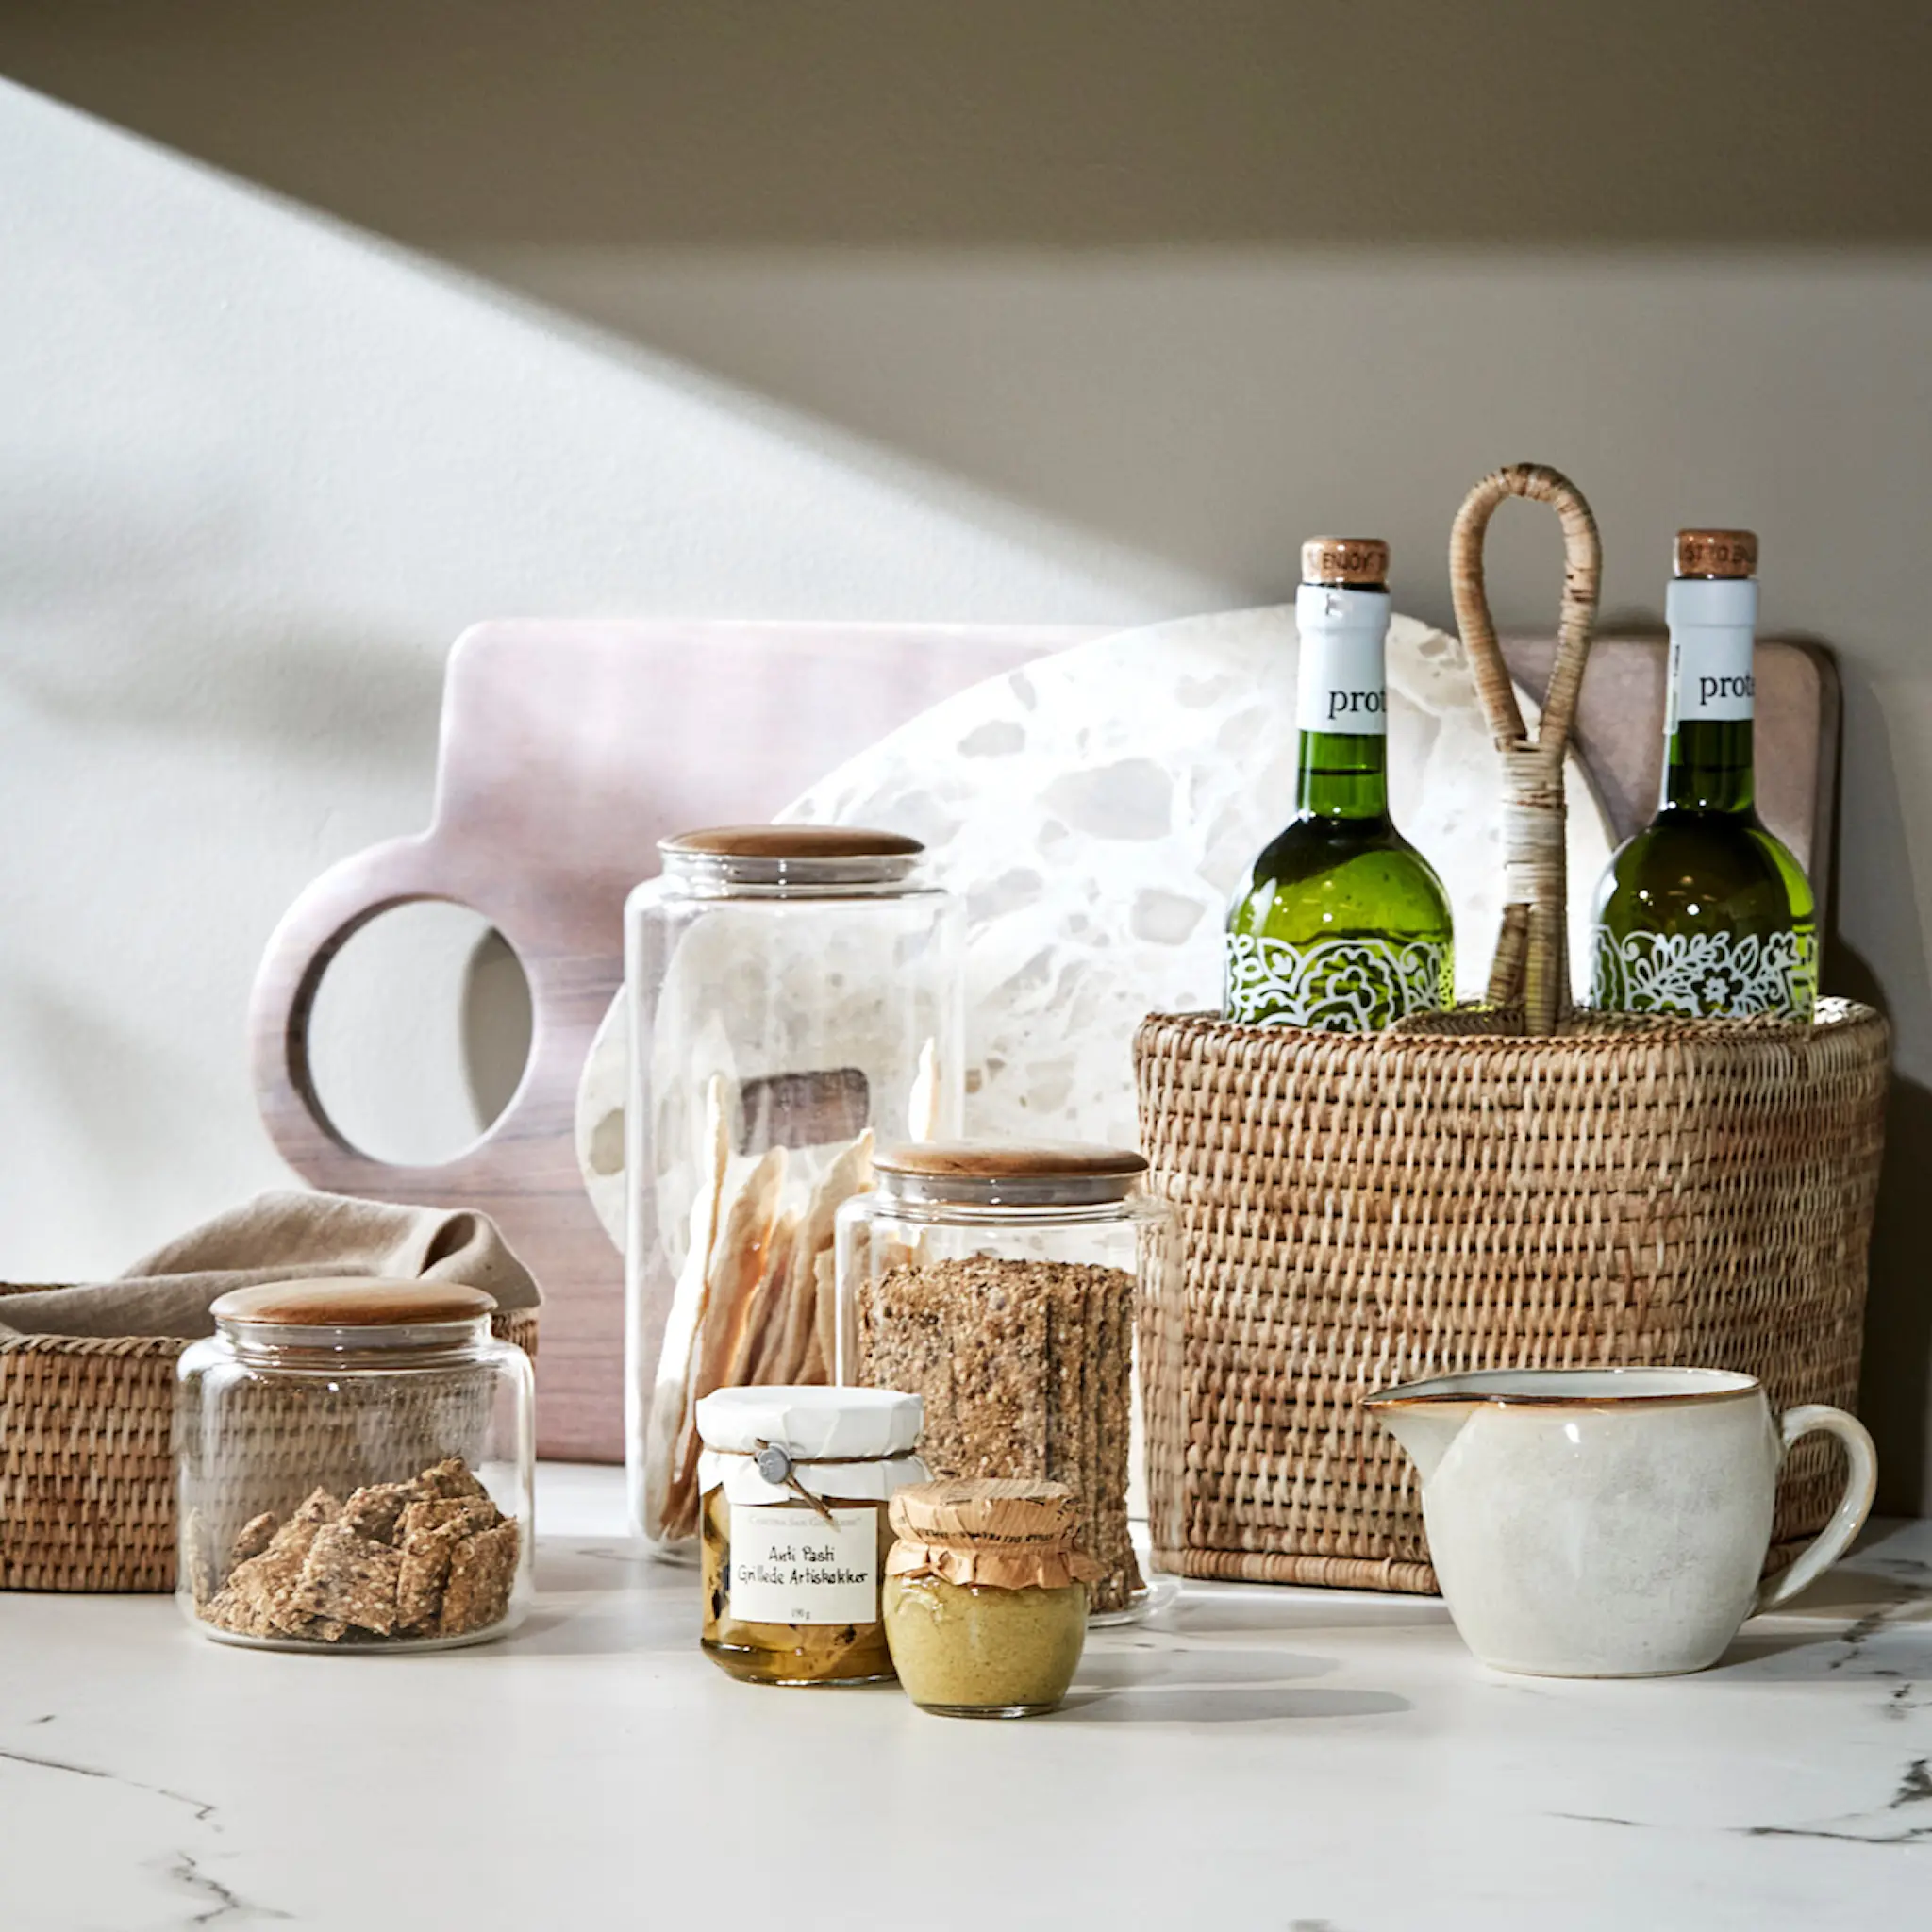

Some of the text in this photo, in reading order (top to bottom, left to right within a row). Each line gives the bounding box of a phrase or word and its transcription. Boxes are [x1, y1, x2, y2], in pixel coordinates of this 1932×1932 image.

[768, 1545, 835, 1563] Anti Pasti
[738, 1564, 785, 1585] Grillede
